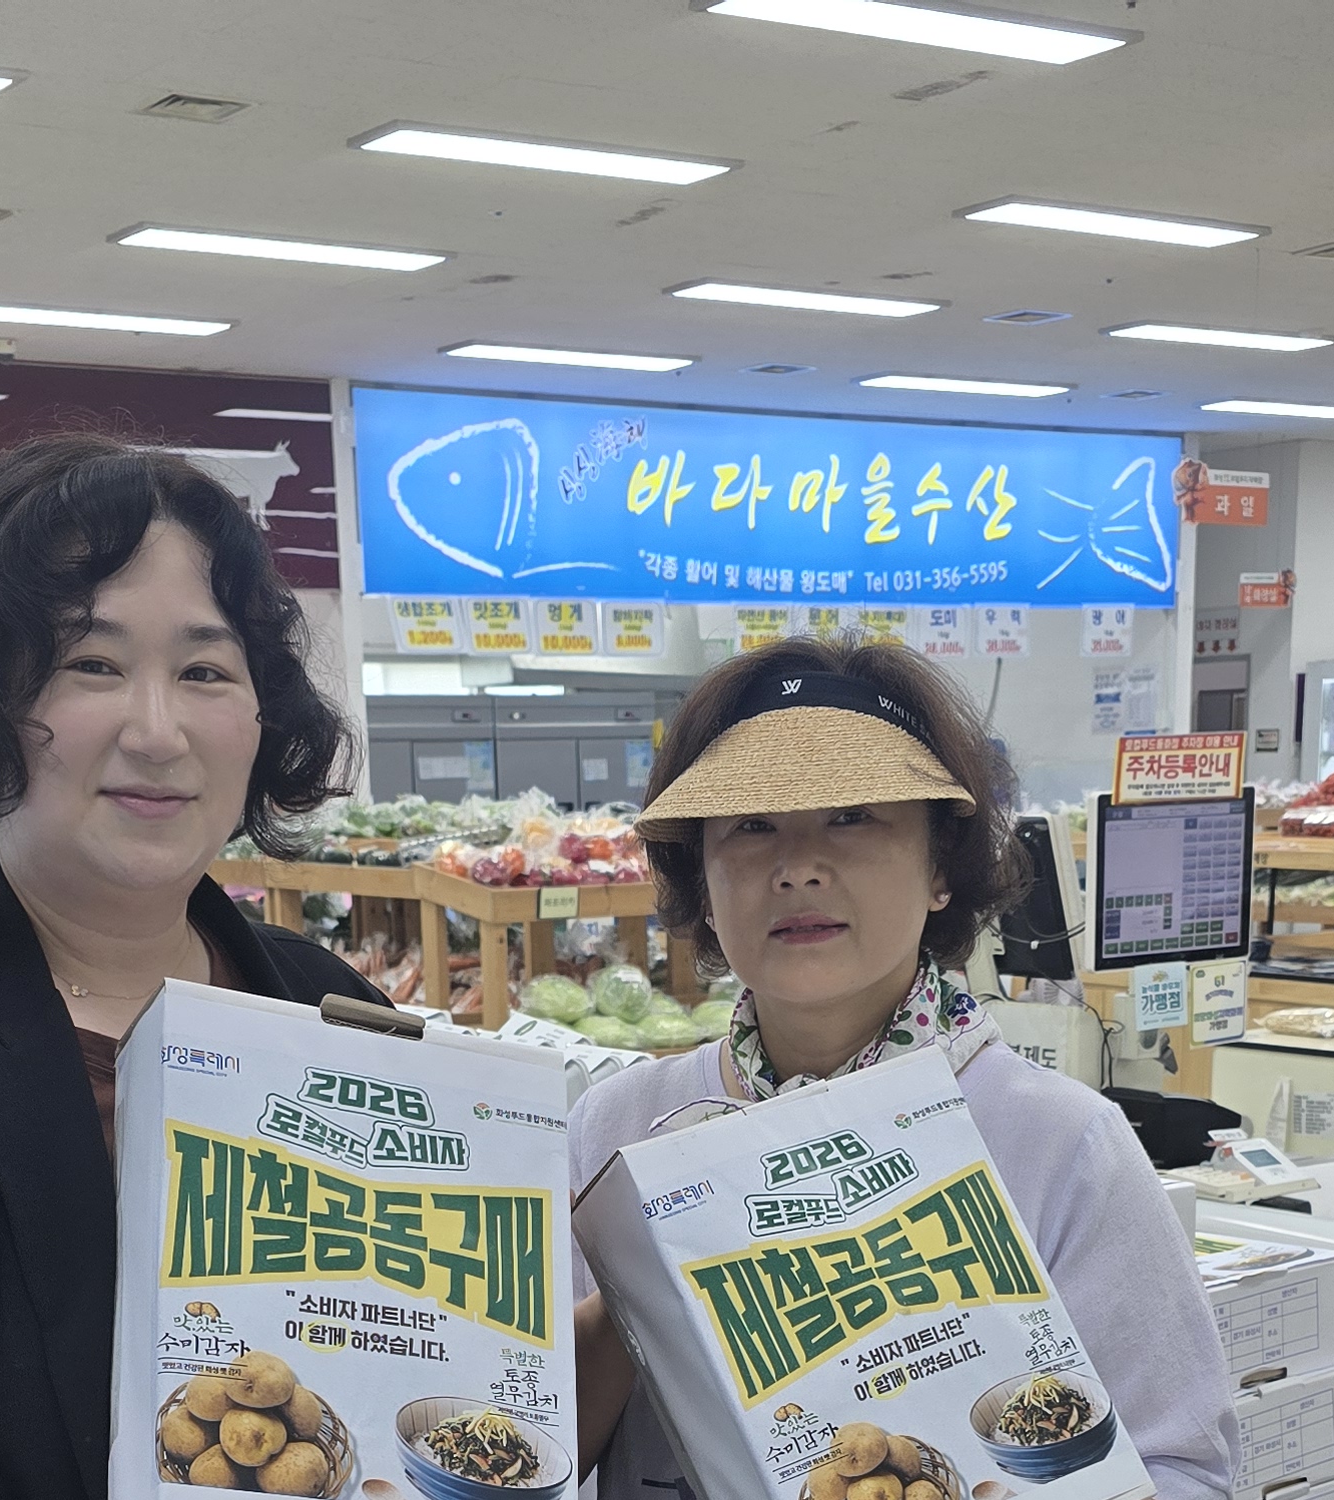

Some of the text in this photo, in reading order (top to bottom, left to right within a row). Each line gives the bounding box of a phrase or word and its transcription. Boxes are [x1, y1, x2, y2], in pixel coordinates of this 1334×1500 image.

[865, 572, 888, 592] Tel
[893, 560, 1007, 592] 031-356-5595
[878, 695, 917, 727] WHITE
[1223, 735, 1238, 746] 안내
[1126, 753, 1231, 780] 주차등록안내
[1141, 991, 1181, 1012] 가맹점
[304, 1072, 428, 1121] 2026
[266, 1103, 466, 1166] 로컬푸드 소비자
[769, 1132, 868, 1183] 2026
[642, 1180, 714, 1219] 화성특례시
[752, 1197, 843, 1231] 로컬푸드
[836, 1153, 915, 1207] 소비자
[168, 1129, 547, 1341] 제철공동구매
[690, 1169, 1041, 1399] 제철공동구매
[157, 1333, 251, 1358] 수미감자
[308, 1324, 346, 1347] 함께
[351, 1330, 450, 1362] 하였습니다.
[1025, 1337, 1077, 1365] 열무김치
[1029, 1324, 1054, 1345] 토종
[503, 1369, 540, 1388] 토종
[874, 1368, 905, 1394] 함께
[906, 1339, 986, 1381] 하였습니다.
[490, 1381, 558, 1409] 열무김치
[765, 1423, 838, 1463] 수미감자
